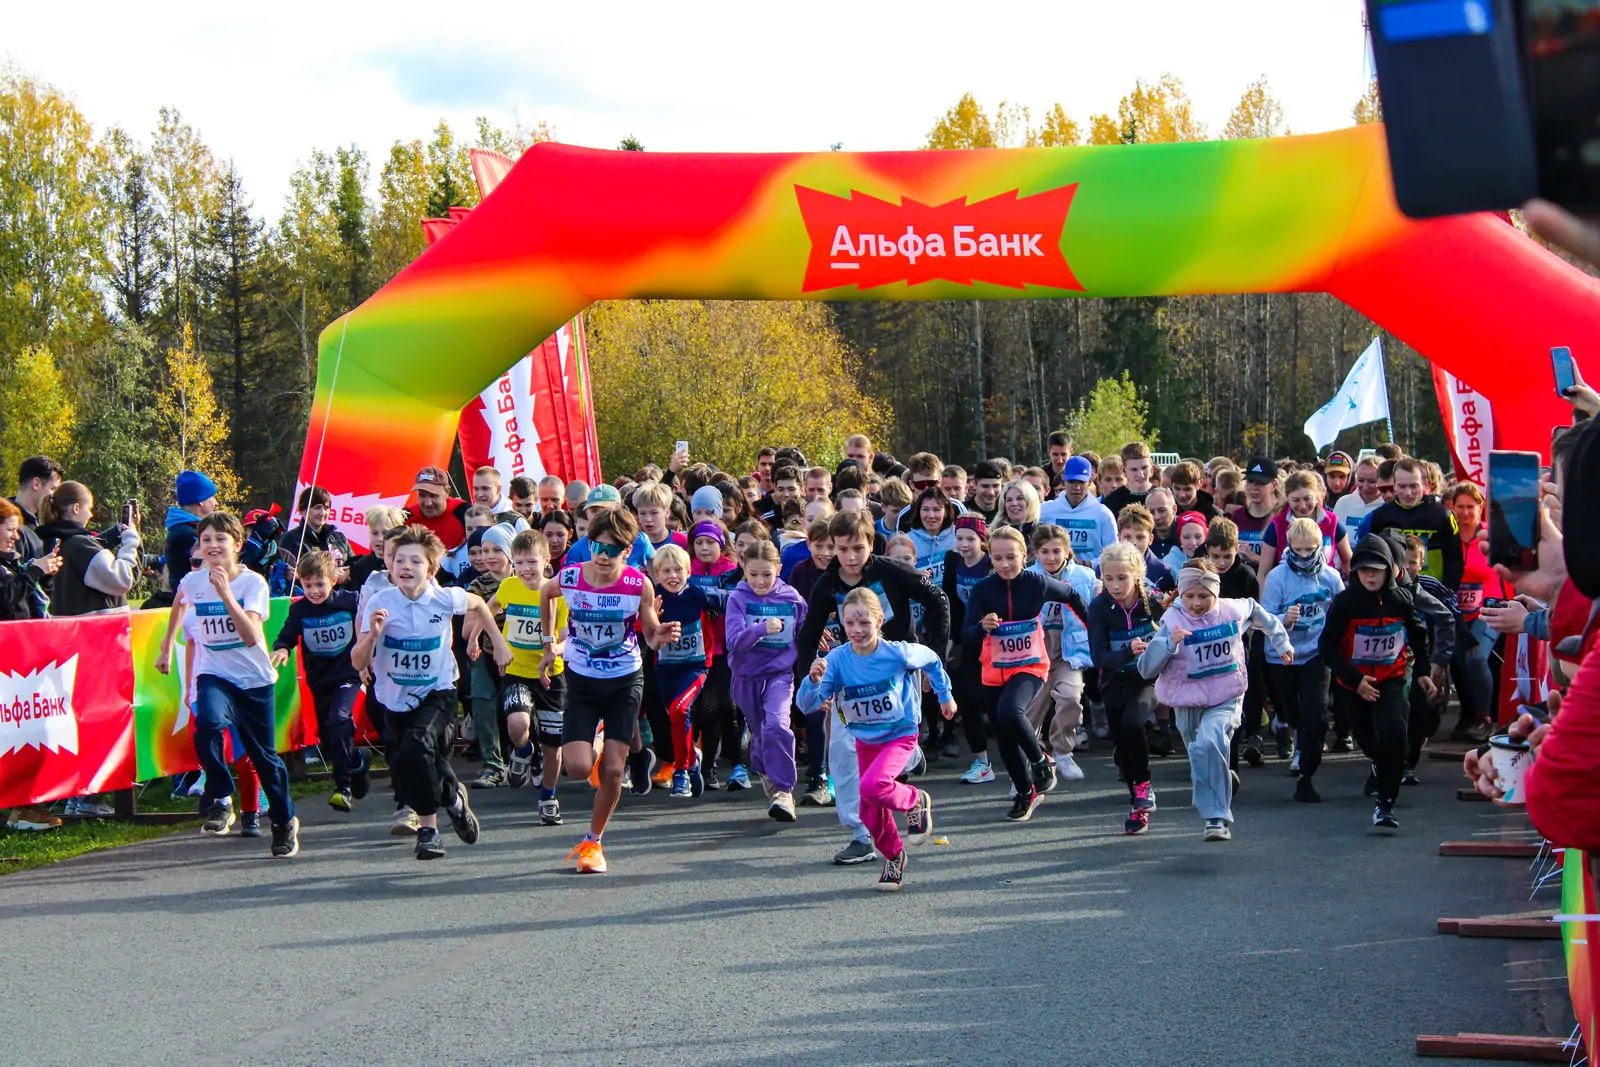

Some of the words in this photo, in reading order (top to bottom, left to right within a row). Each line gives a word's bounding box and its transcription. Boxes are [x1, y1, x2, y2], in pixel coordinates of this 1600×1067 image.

[830, 225, 946, 267] Альфа
[953, 225, 1045, 257] Банк
[1461, 400, 1486, 488] Альфа
[340, 507, 370, 526] Ба
[623, 576, 643, 587] 085
[203, 618, 236, 635] 1116
[313, 626, 345, 645] 1503
[517, 619, 542, 636] 764
[999, 635, 1032, 653] 1906
[1195, 640, 1231, 662] 1700
[1363, 636, 1395, 652] 1718
[391, 651, 431, 670] 1419
[0, 695, 31, 728] ьфа
[32, 692, 67, 719] Банк
[851, 695, 893, 718] 1786
